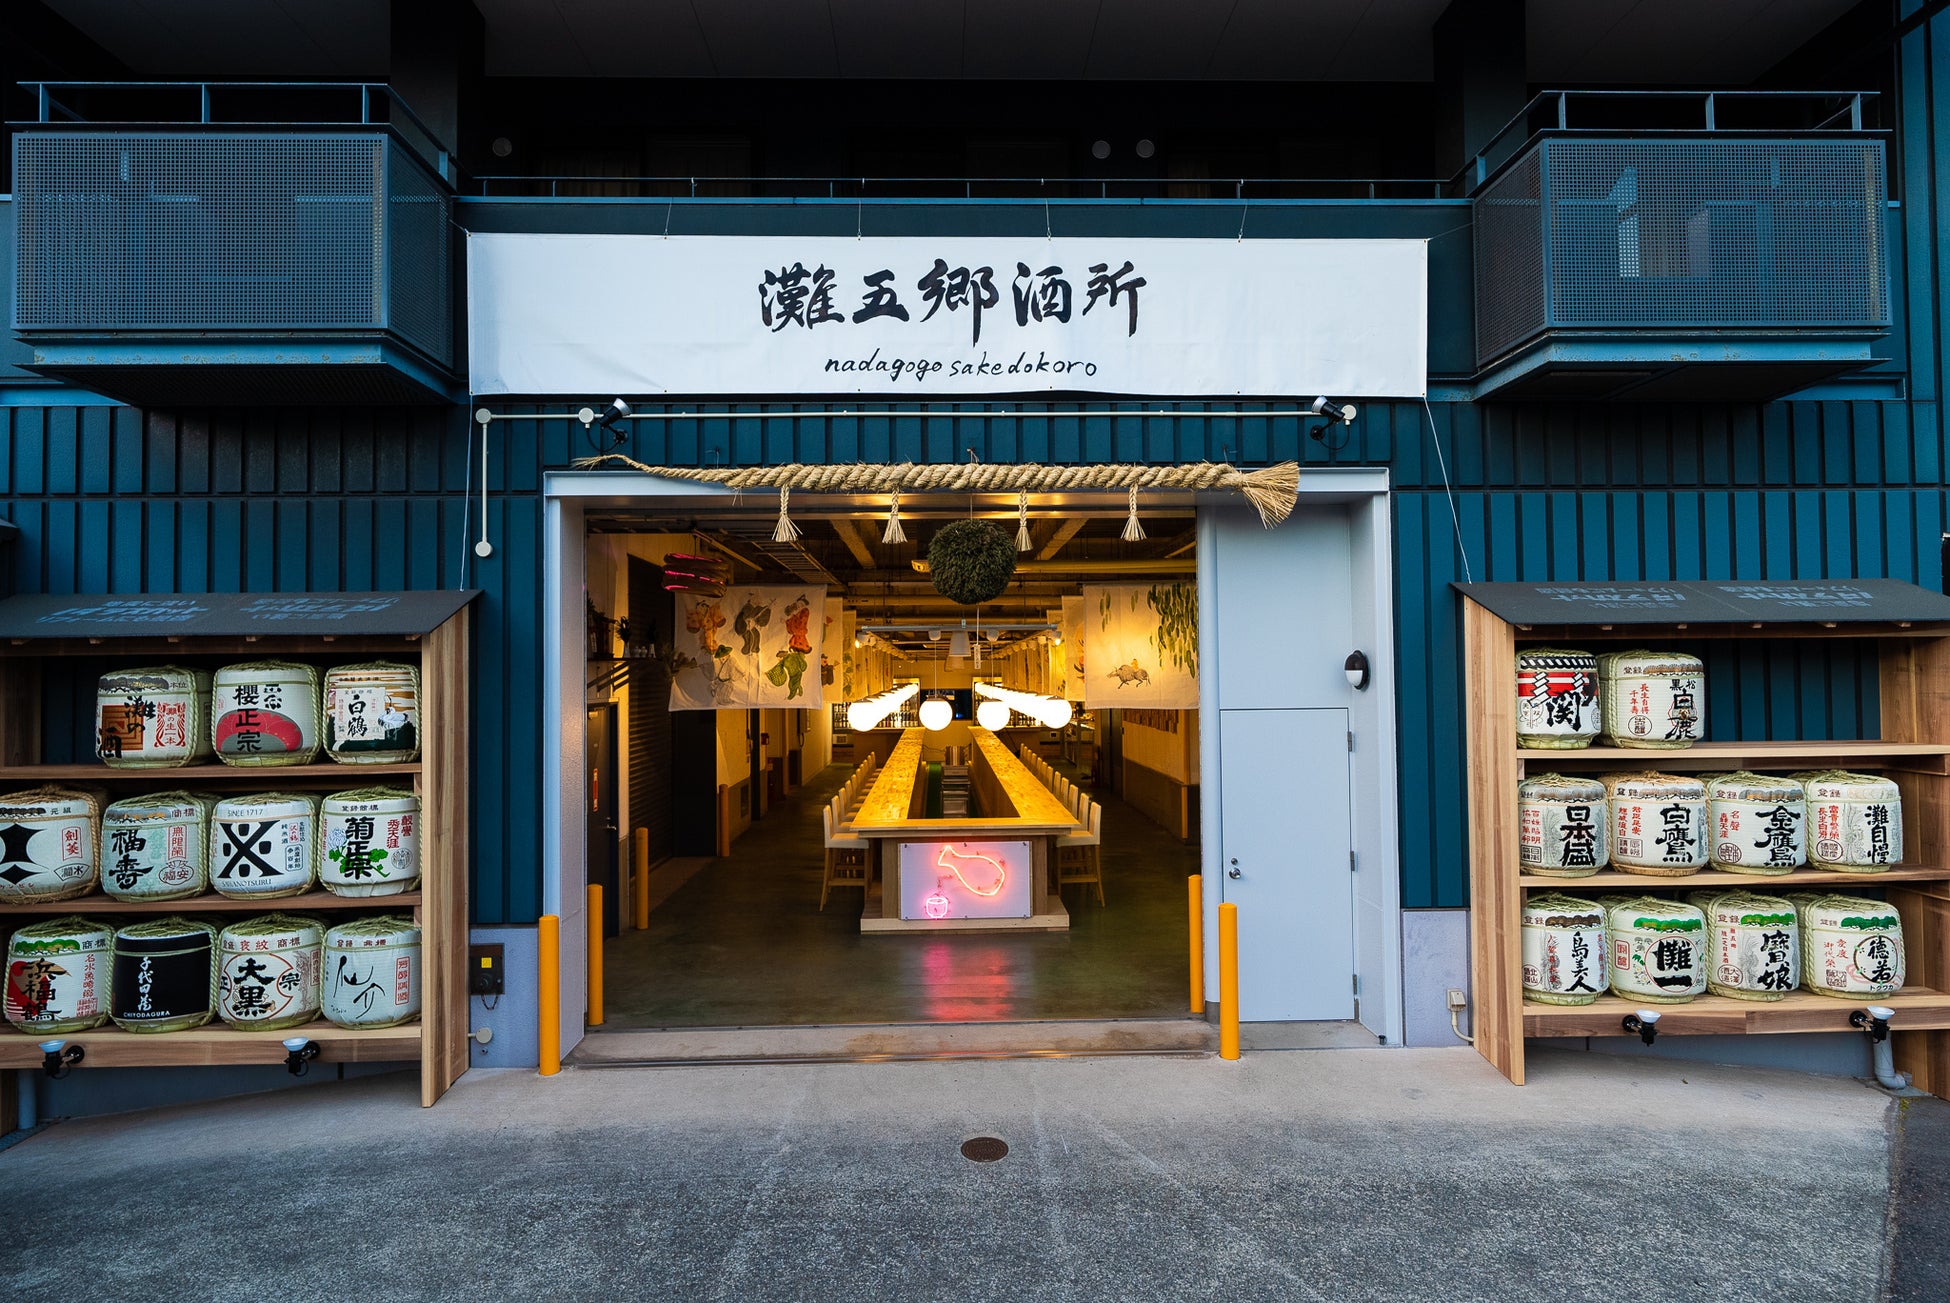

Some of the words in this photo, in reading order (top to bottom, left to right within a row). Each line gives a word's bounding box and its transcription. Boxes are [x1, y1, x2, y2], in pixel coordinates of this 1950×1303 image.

[758, 258, 1147, 348] 灘五郷酒所
[824, 348, 943, 381] nadagogo
[949, 350, 1098, 377] sakedokoro
[347, 694, 369, 738] 白鶴
[246, 808, 264, 816] 1717
[1559, 806, 1597, 867] 日本盛
[1655, 803, 1697, 863] 白鷹
[1864, 804, 1890, 865] 灘自慢
[343, 816, 376, 880] 菊正宗
[82, 939, 107, 950] 商標
[1564, 931, 1597, 992] 島美人
[123, 1010, 170, 1018] CHIYODAGURA
